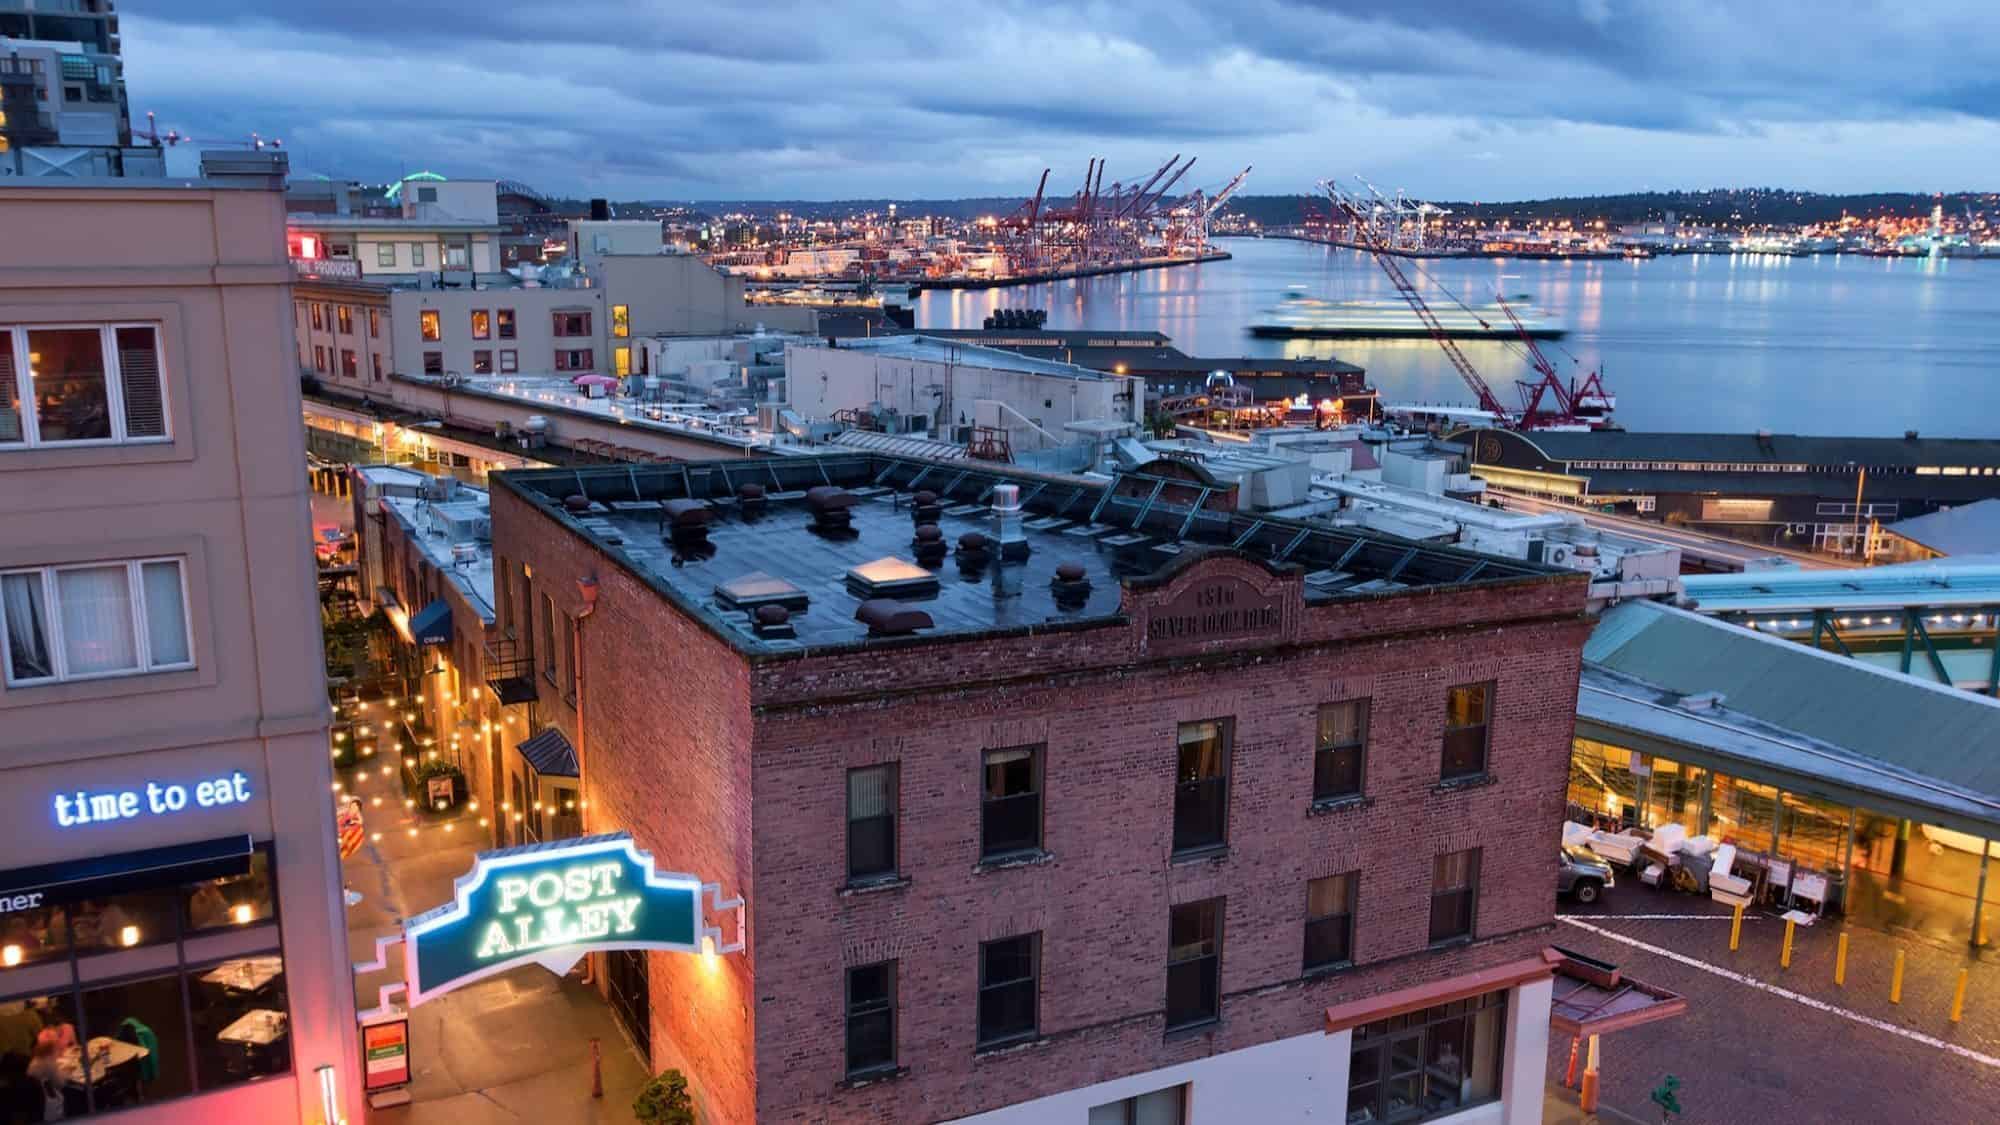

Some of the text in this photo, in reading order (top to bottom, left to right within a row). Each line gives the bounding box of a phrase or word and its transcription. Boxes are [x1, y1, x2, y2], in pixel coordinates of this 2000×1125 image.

[54, 772, 250, 826] time to eat
[0, 893, 43, 912] ner
[496, 861, 622, 913] POST
[475, 896, 641, 957] ALLEY
